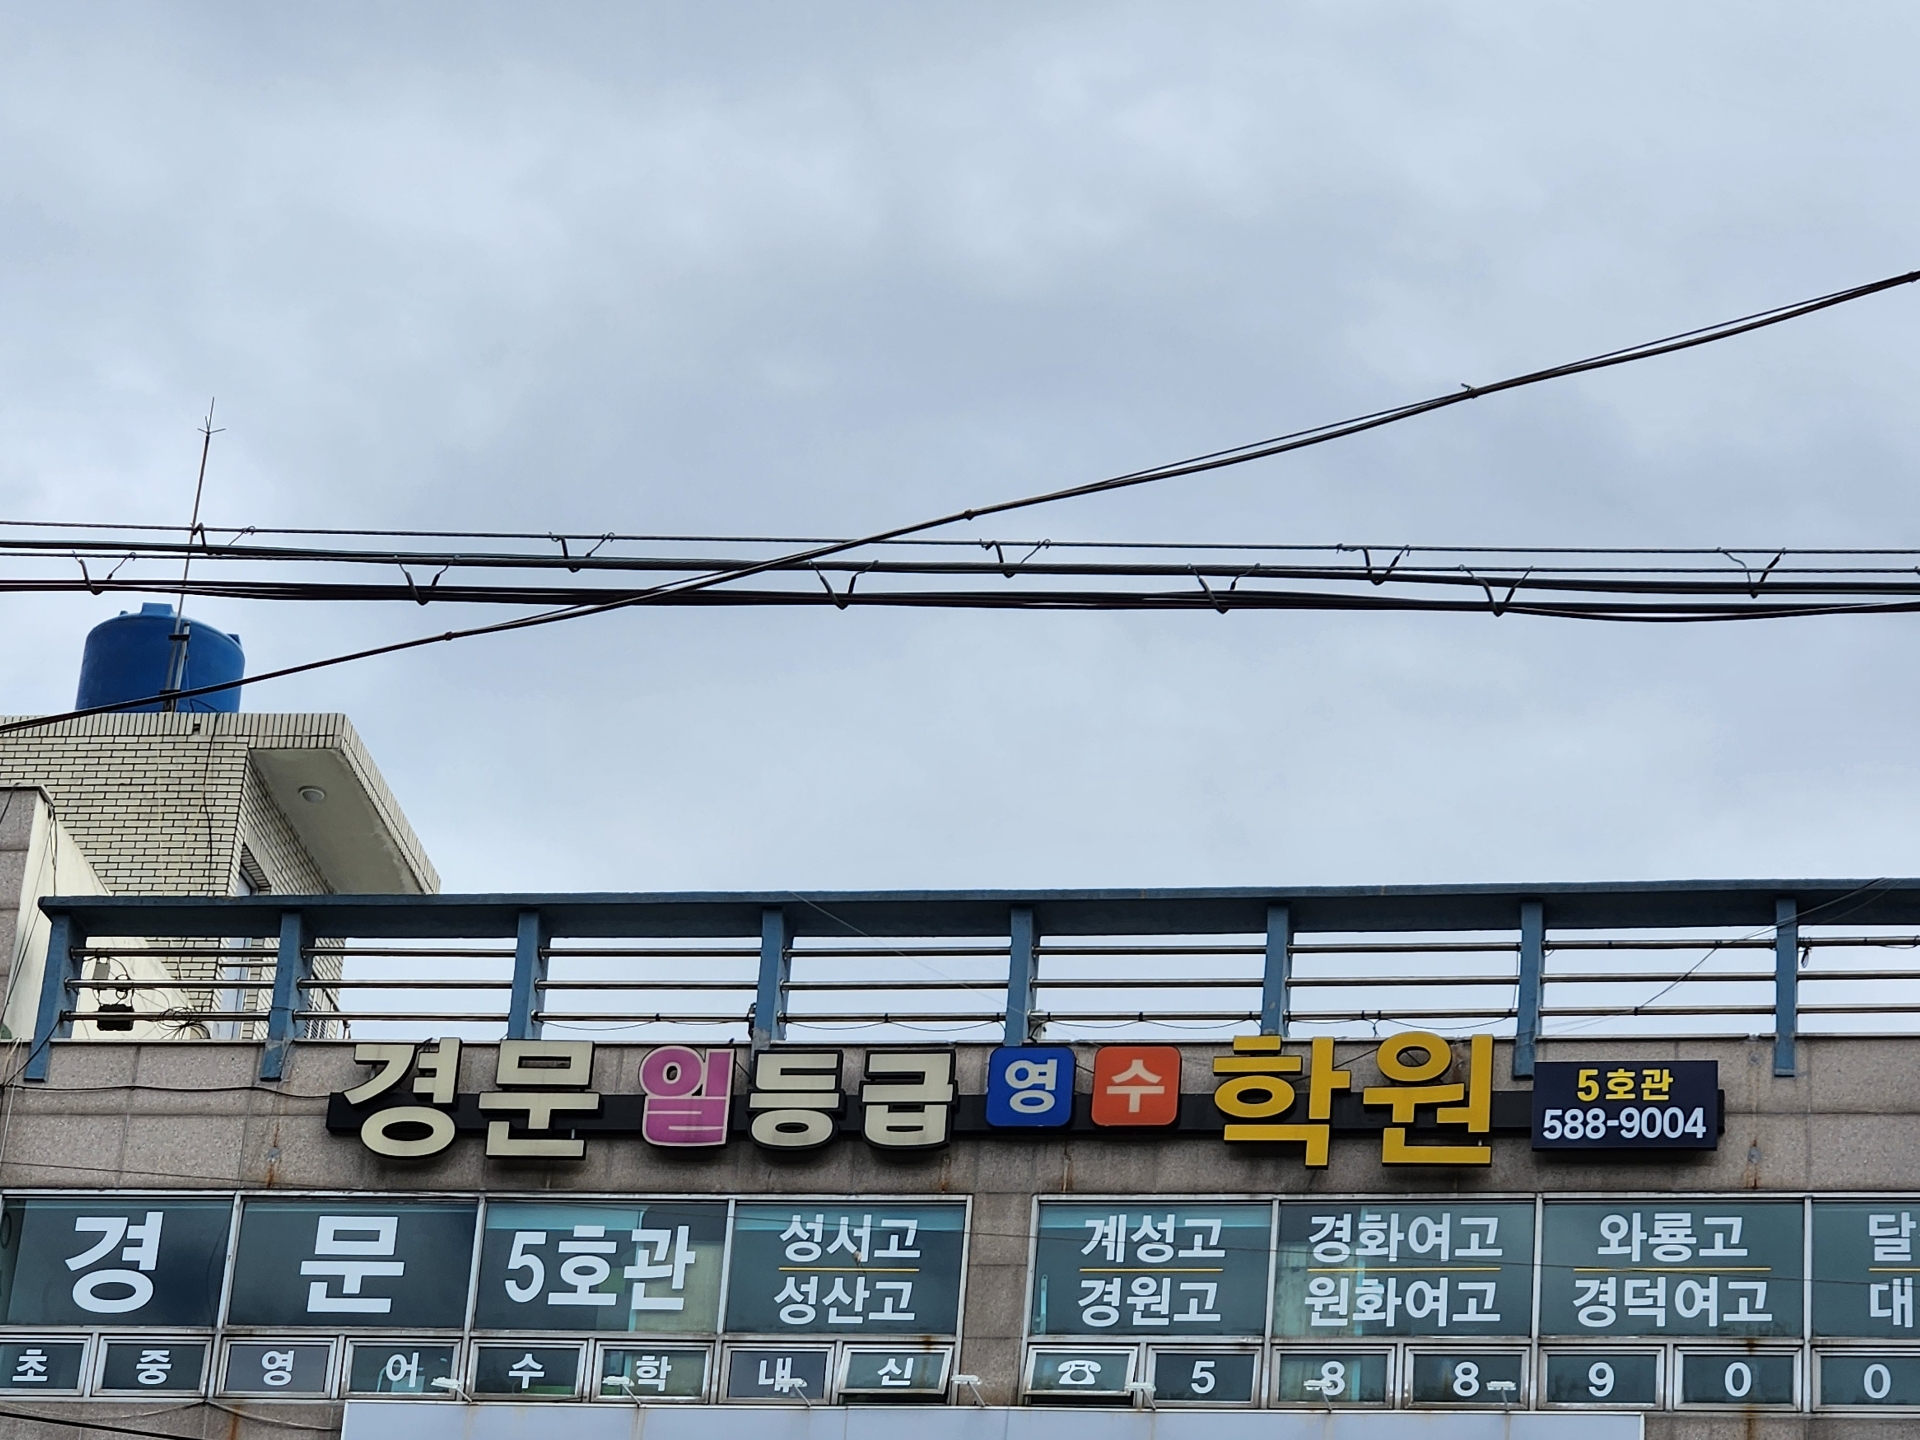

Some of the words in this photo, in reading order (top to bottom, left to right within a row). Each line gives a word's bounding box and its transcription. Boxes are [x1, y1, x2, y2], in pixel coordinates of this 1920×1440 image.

[345, 1037, 599, 1158] 경문
[640, 1045, 955, 1147] 일등급
[1213, 1031, 1493, 1167] 학원
[1577, 1068, 1674, 1102] 5호관
[1542, 1107, 1707, 1141] 588-9004
[779, 1214, 921, 1263] 성서고
[1081, 1214, 1226, 1263] 계성고
[1309, 1213, 1503, 1263] 경화여고
[1597, 1212, 1749, 1262] 와룡고
[1868, 1211, 1920, 1262] 달
[65, 1211, 164, 1314] 경
[300, 1215, 405, 1313] 문
[504, 1225, 696, 1311] 5호관
[773, 1276, 916, 1325] 성산고
[1078, 1276, 1222, 1327] 경원고
[1305, 1276, 1501, 1327] 원화여고
[1573, 1276, 1773, 1327] 경덕여고
[1869, 1277, 1920, 1328] 대
[12, 1349, 48, 1382] 초
[136, 1350, 172, 1385] 중
[261, 1350, 295, 1386] 영
[386, 1352, 420, 1387] 어
[508, 1353, 545, 1388] 수
[636, 1355, 672, 1392] 학
[877, 1357, 914, 1386] 신
[1190, 1361, 1216, 1394] 5
[1320, 1361, 1346, 1396] 8
[1453, 1361, 1479, 1397] 8
[1588, 1362, 1615, 1397] 9
[1724, 1362, 1752, 1397] 0
[1863, 1364, 1891, 1399] 0
